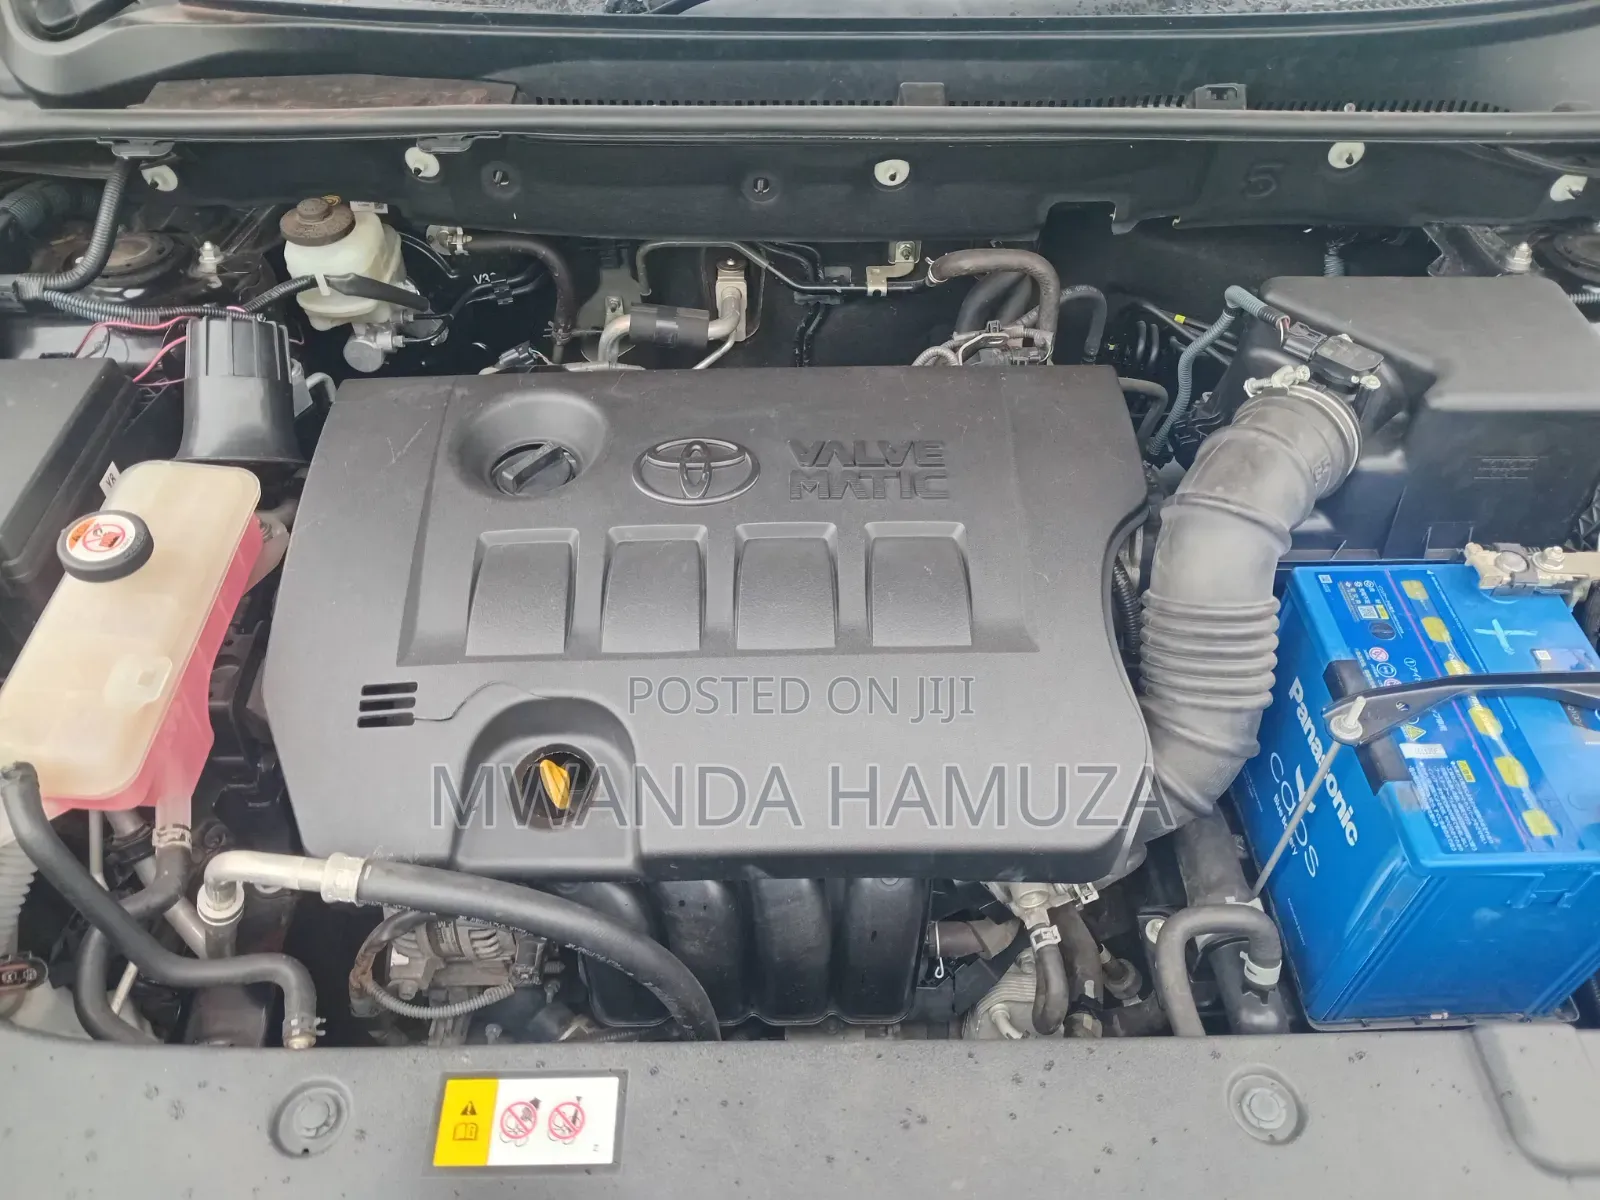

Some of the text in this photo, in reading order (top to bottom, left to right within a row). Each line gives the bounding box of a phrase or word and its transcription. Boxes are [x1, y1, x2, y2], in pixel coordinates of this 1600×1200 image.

[786, 440, 945, 468] VALVE
[789, 469, 949, 500] MATIC
[1280, 814, 1298, 856] Baery
